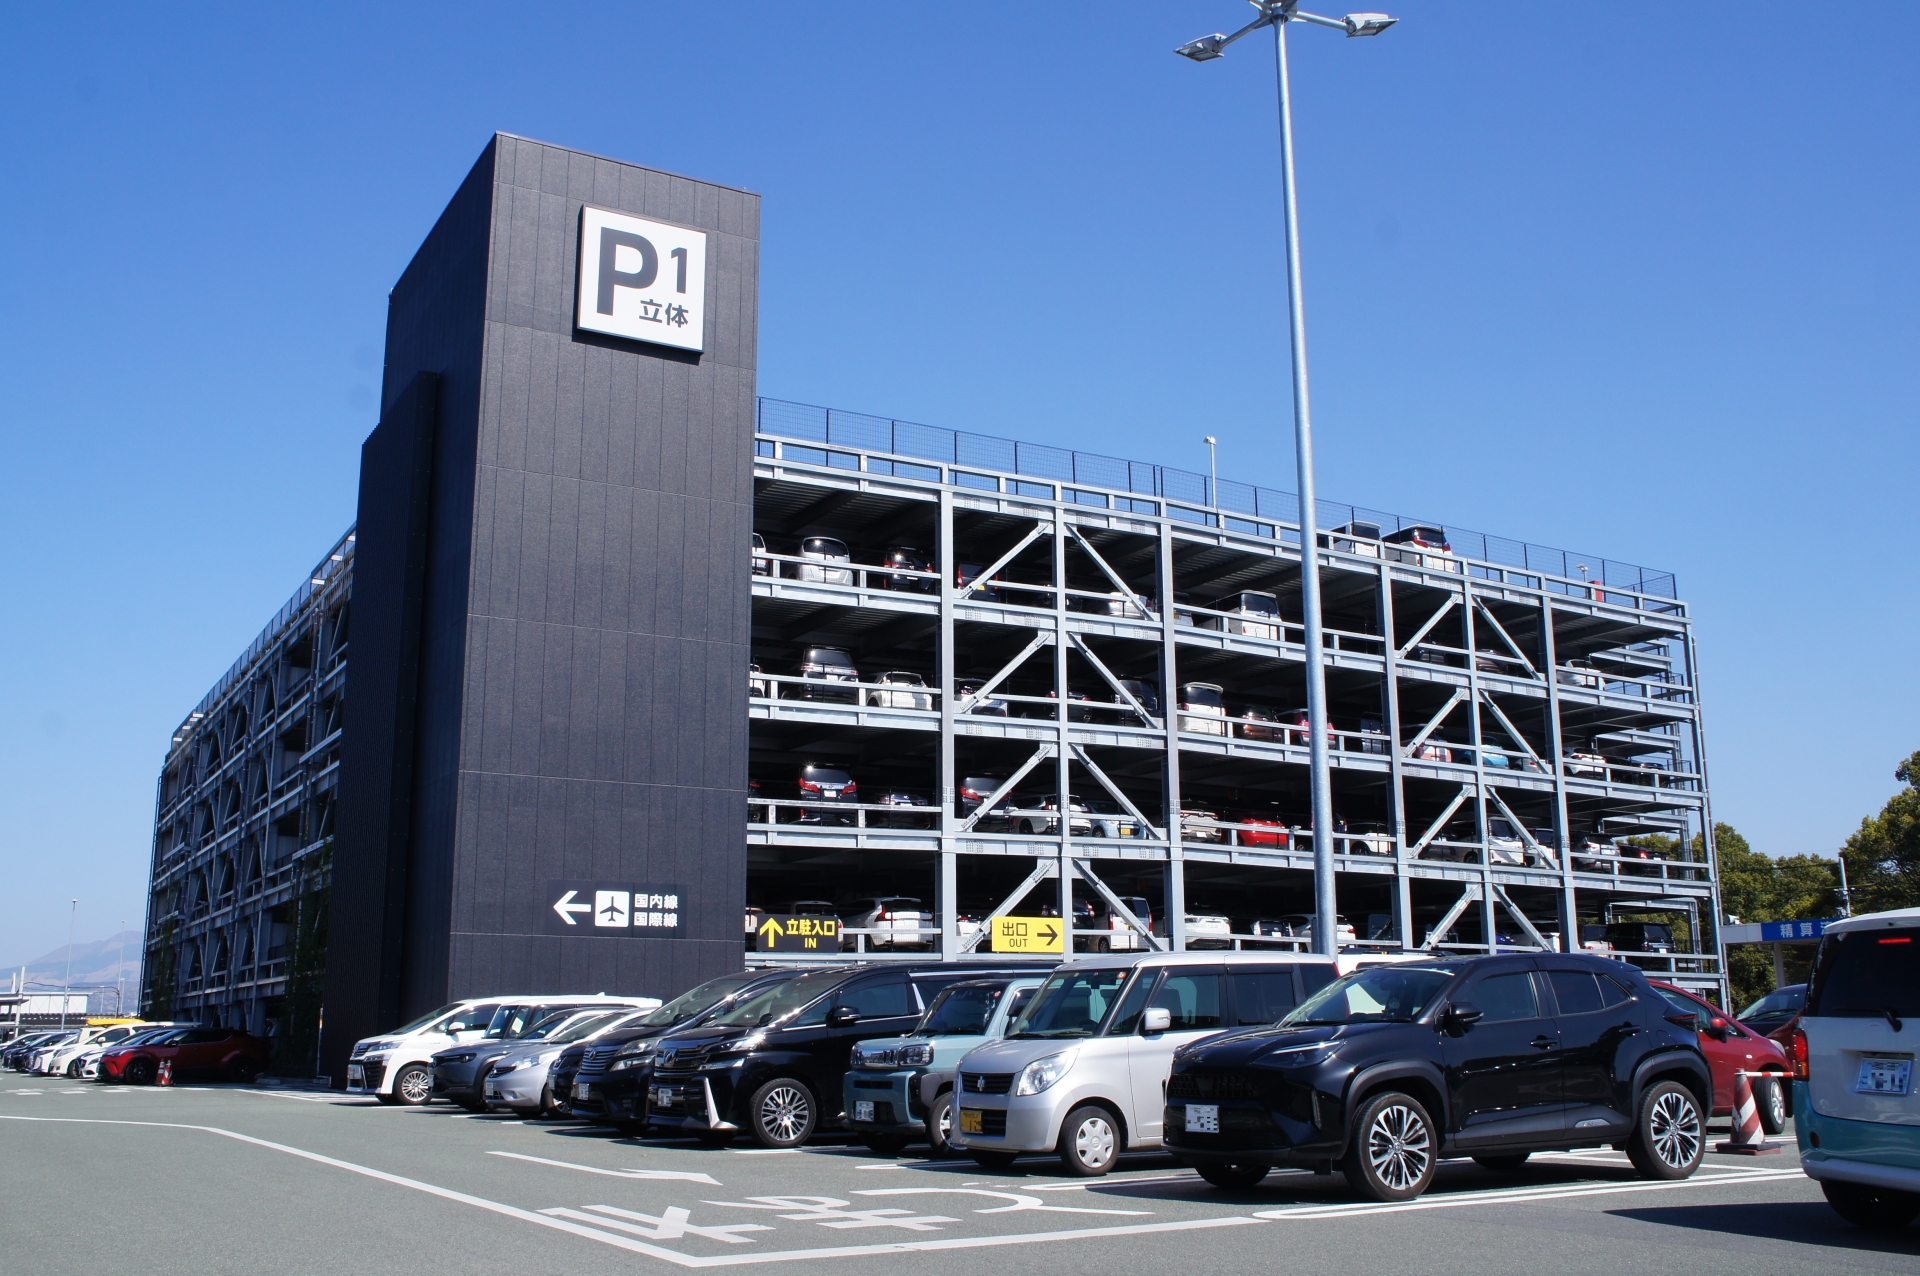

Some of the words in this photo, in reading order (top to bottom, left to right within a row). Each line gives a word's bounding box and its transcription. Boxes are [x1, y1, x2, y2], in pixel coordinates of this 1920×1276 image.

[638, 298, 689, 328] 立体
[634, 893, 678, 909] 国内線
[633, 911, 678, 928] 国際線
[786, 918, 835, 937] 立駐入口
[1001, 921, 1028, 937] 出口
[804, 937, 817, 949] IN
[1008, 938, 1028, 949] OUT
